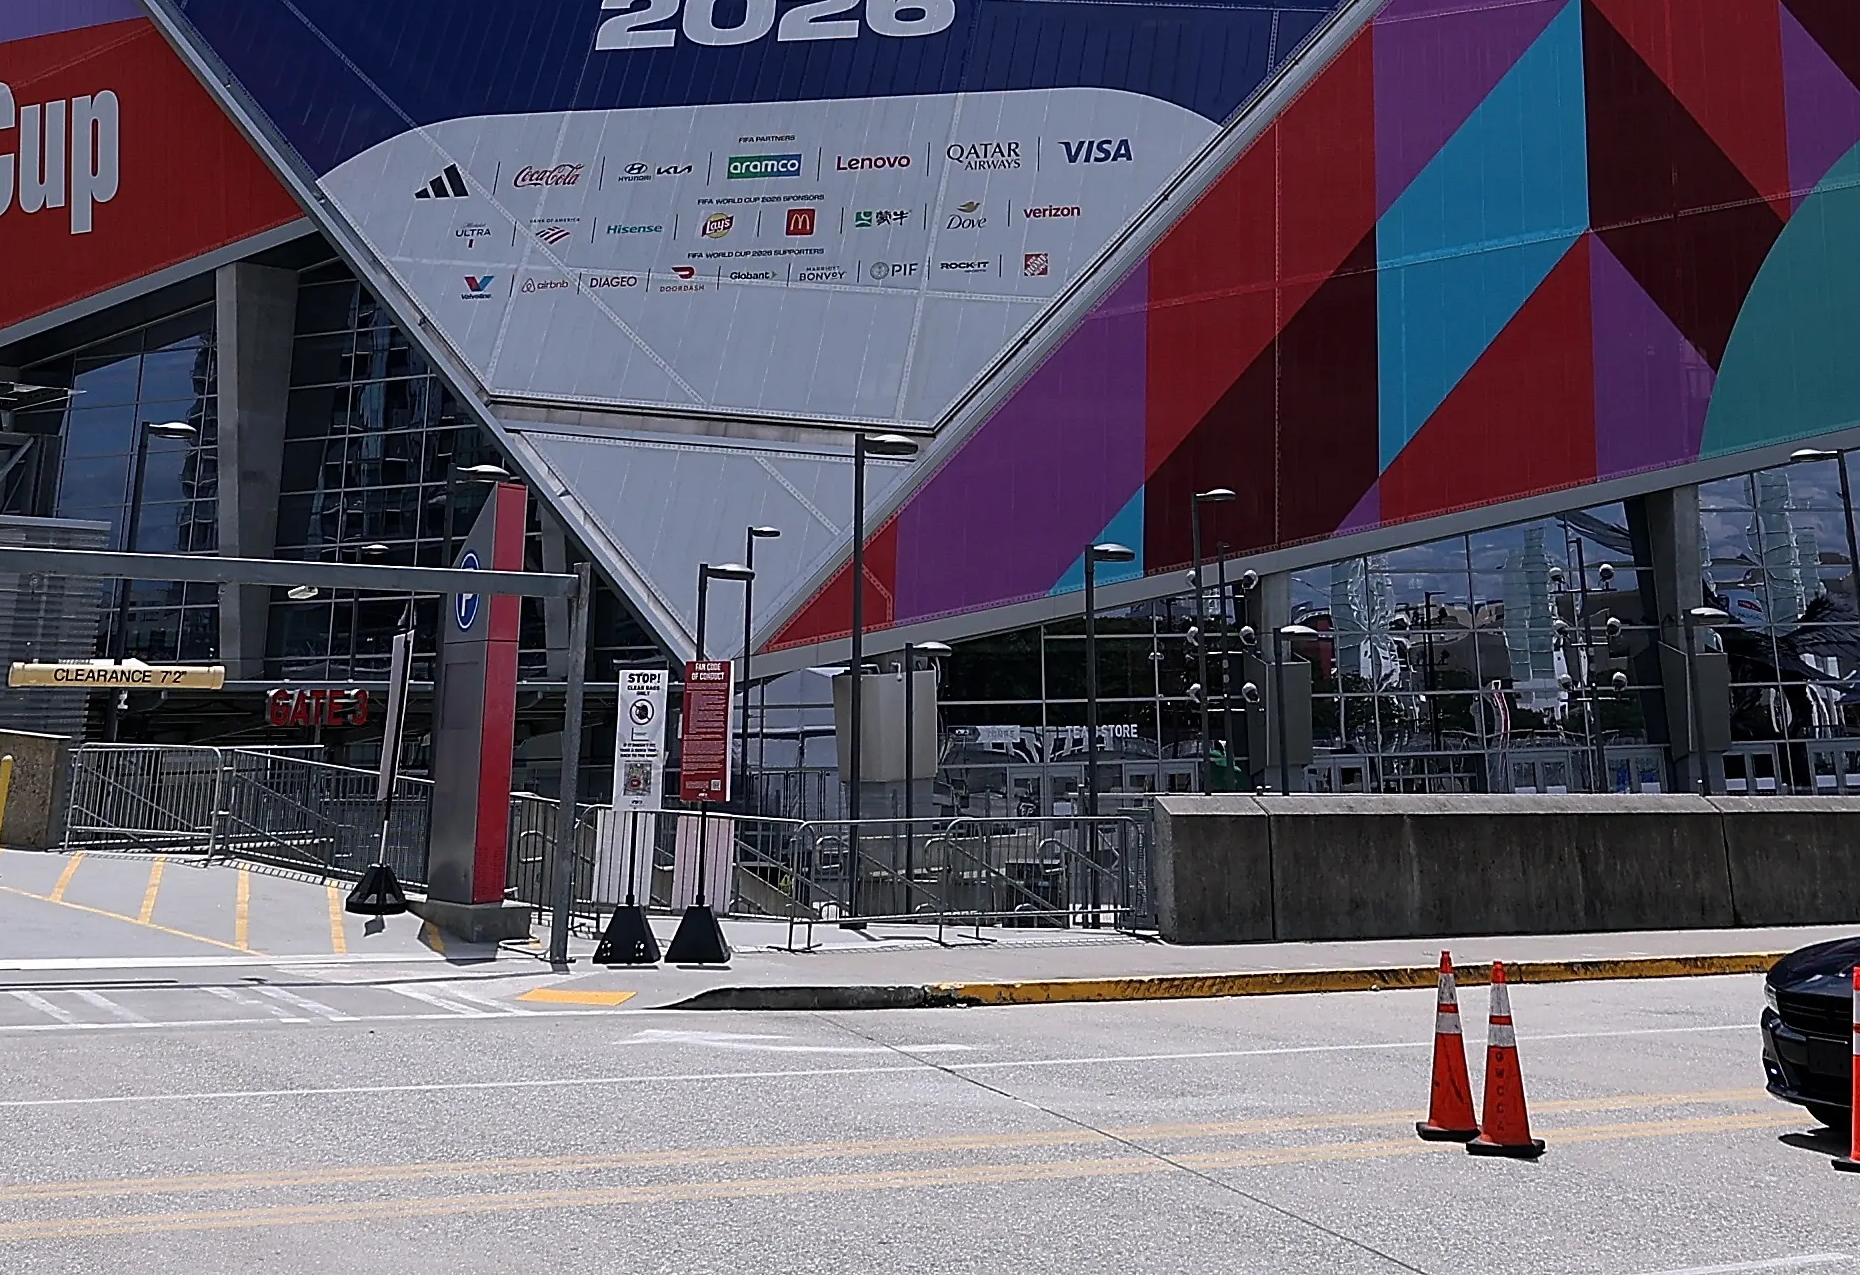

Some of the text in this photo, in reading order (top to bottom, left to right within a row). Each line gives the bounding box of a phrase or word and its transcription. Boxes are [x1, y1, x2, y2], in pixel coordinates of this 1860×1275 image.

[947, 141, 1020, 162] QATAR
[1058, 139, 1133, 164] VISA
[729, 158, 798, 173] aramco
[836, 154, 911, 171] Lenovo
[965, 159, 1021, 171] AIRWAYS
[715, 197, 743, 205] WORLD
[783, 194, 825, 202] SPONSORS
[1024, 205, 1081, 219] verizon
[946, 214, 987, 230] Dove
[455, 228, 491, 237] ULTRA
[606, 224, 663, 234] Hisense
[706, 251, 734, 259] WORLD
[730, 270, 770, 280] Globant
[799, 270, 846, 281] BONVOY
[891, 262, 918, 277] PIF
[537, 279, 569, 290] airbnb
[590, 276, 637, 288] DIAGEO
[53, 668, 187, 683] CLEARANCE 7'2"
[628, 673, 661, 683] STOP!
[269, 689, 369, 726] GATE 3
[1103, 724, 1138, 738] STORE
